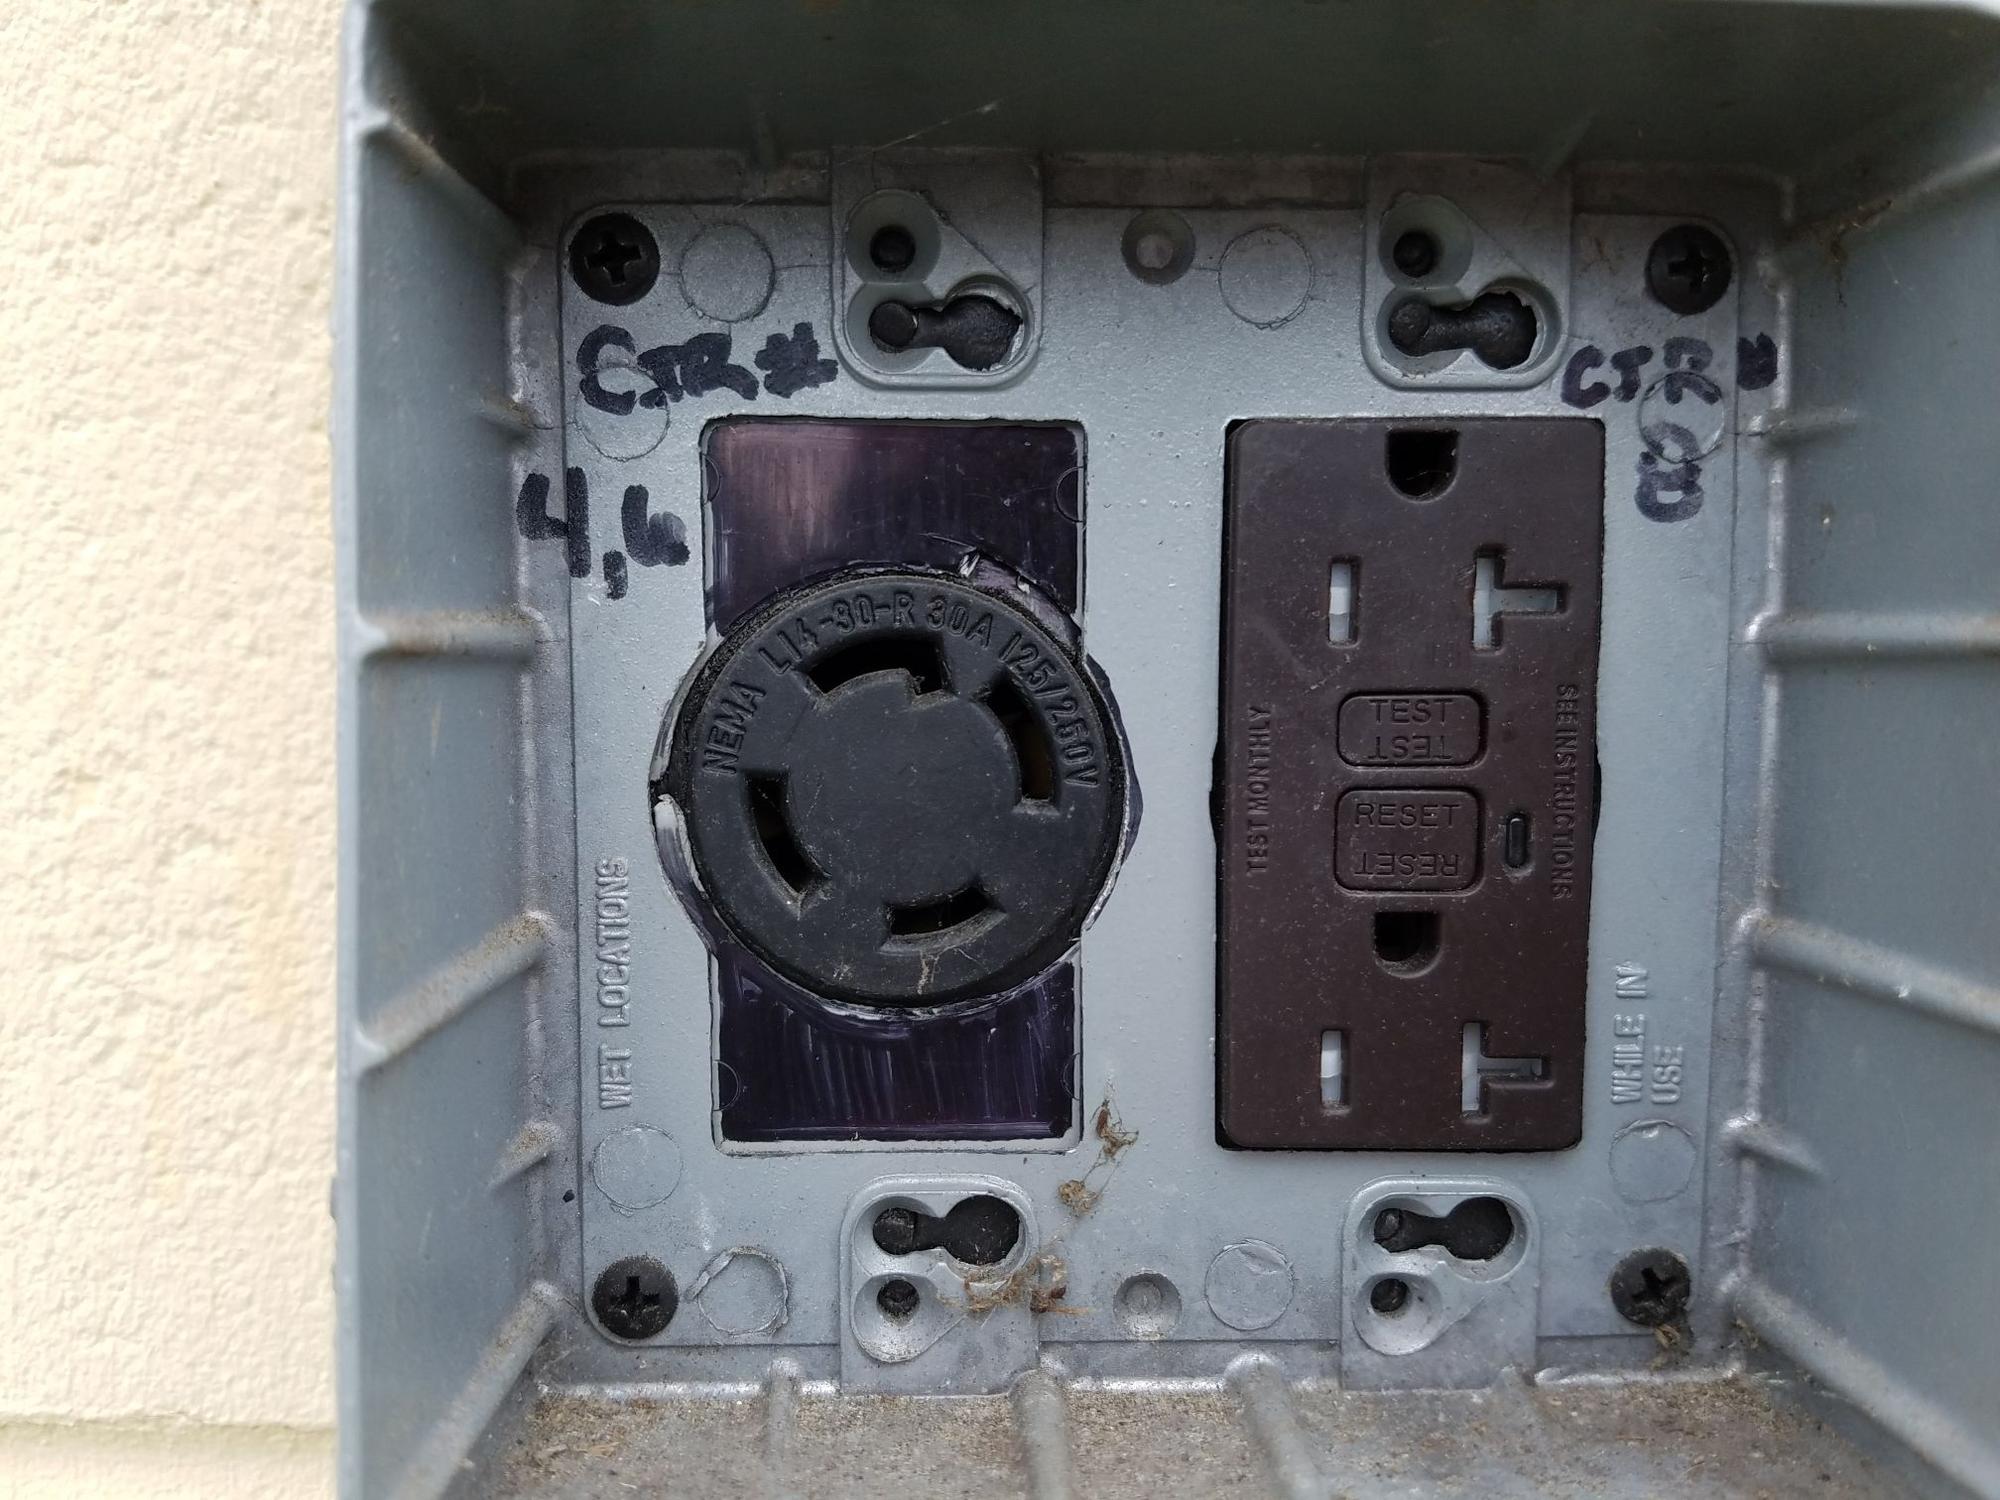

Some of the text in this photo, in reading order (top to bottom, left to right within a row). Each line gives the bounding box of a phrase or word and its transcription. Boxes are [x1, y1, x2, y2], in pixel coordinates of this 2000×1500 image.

[1560, 336, 1723, 410] CTR
[702, 681, 766, 776] NEMA
[926, 595, 994, 649] 30A
[999, 632, 1099, 789] 125/250V
[1367, 699, 1454, 725] TEST
[1366, 735, 1453, 761] TEST
[1246, 705, 1273, 873] TEST MONTHLY
[1353, 801, 1462, 829] RESET
[1551, 683, 1580, 900] SEE INSTRUCTIONS
[1353, 852, 1461, 877] RESET
[596, 856, 633, 1109] WET LOCATIONS
[1610, 960, 1648, 1105] WHILE IN
[1650, 1044, 1684, 1105] USE
